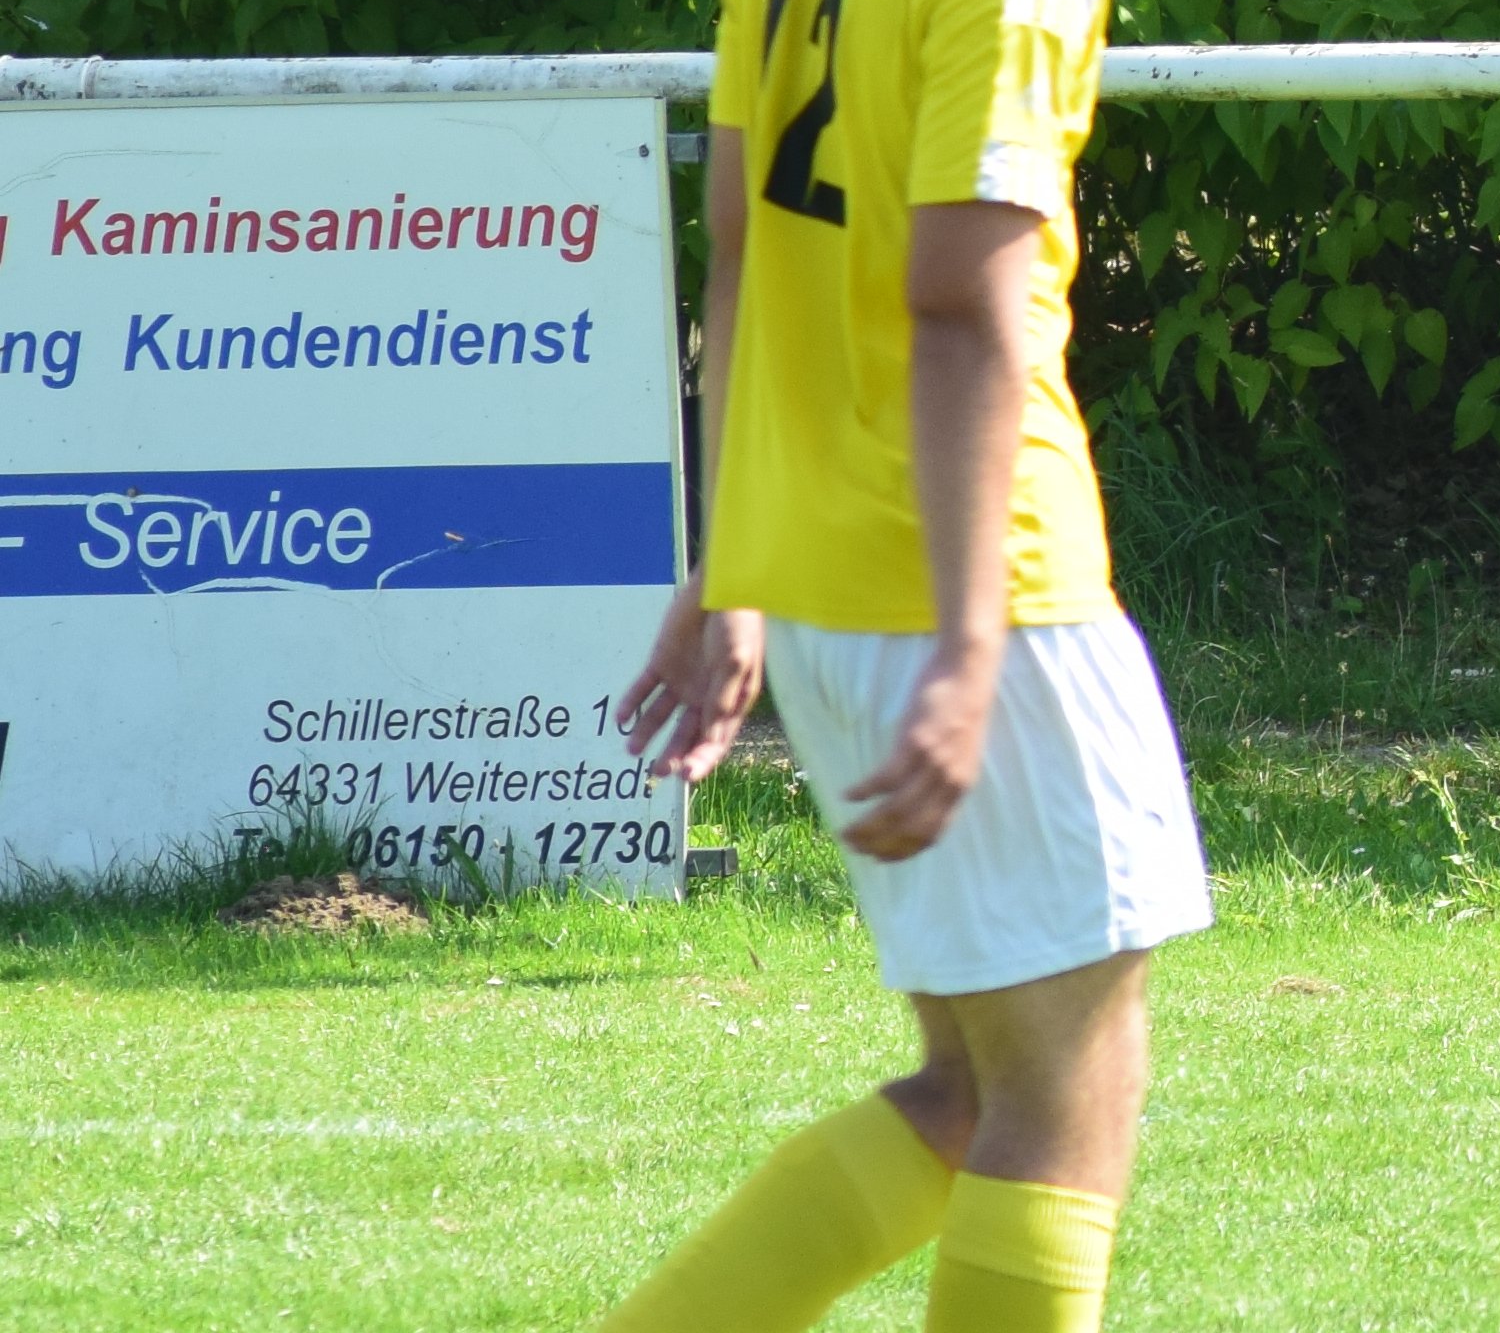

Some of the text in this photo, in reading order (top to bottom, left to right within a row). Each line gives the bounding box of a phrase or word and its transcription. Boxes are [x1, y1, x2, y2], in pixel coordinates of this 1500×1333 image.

[51, 193, 600, 263] Kaminsanierung
[123, 307, 594, 372] Kundendienst
[79, 490, 372, 569] Service
[263, 694, 571, 743] Schillerstraße
[248, 757, 655, 807] 64331 Weiterstadt
[534, 819, 672, 865] 12730
